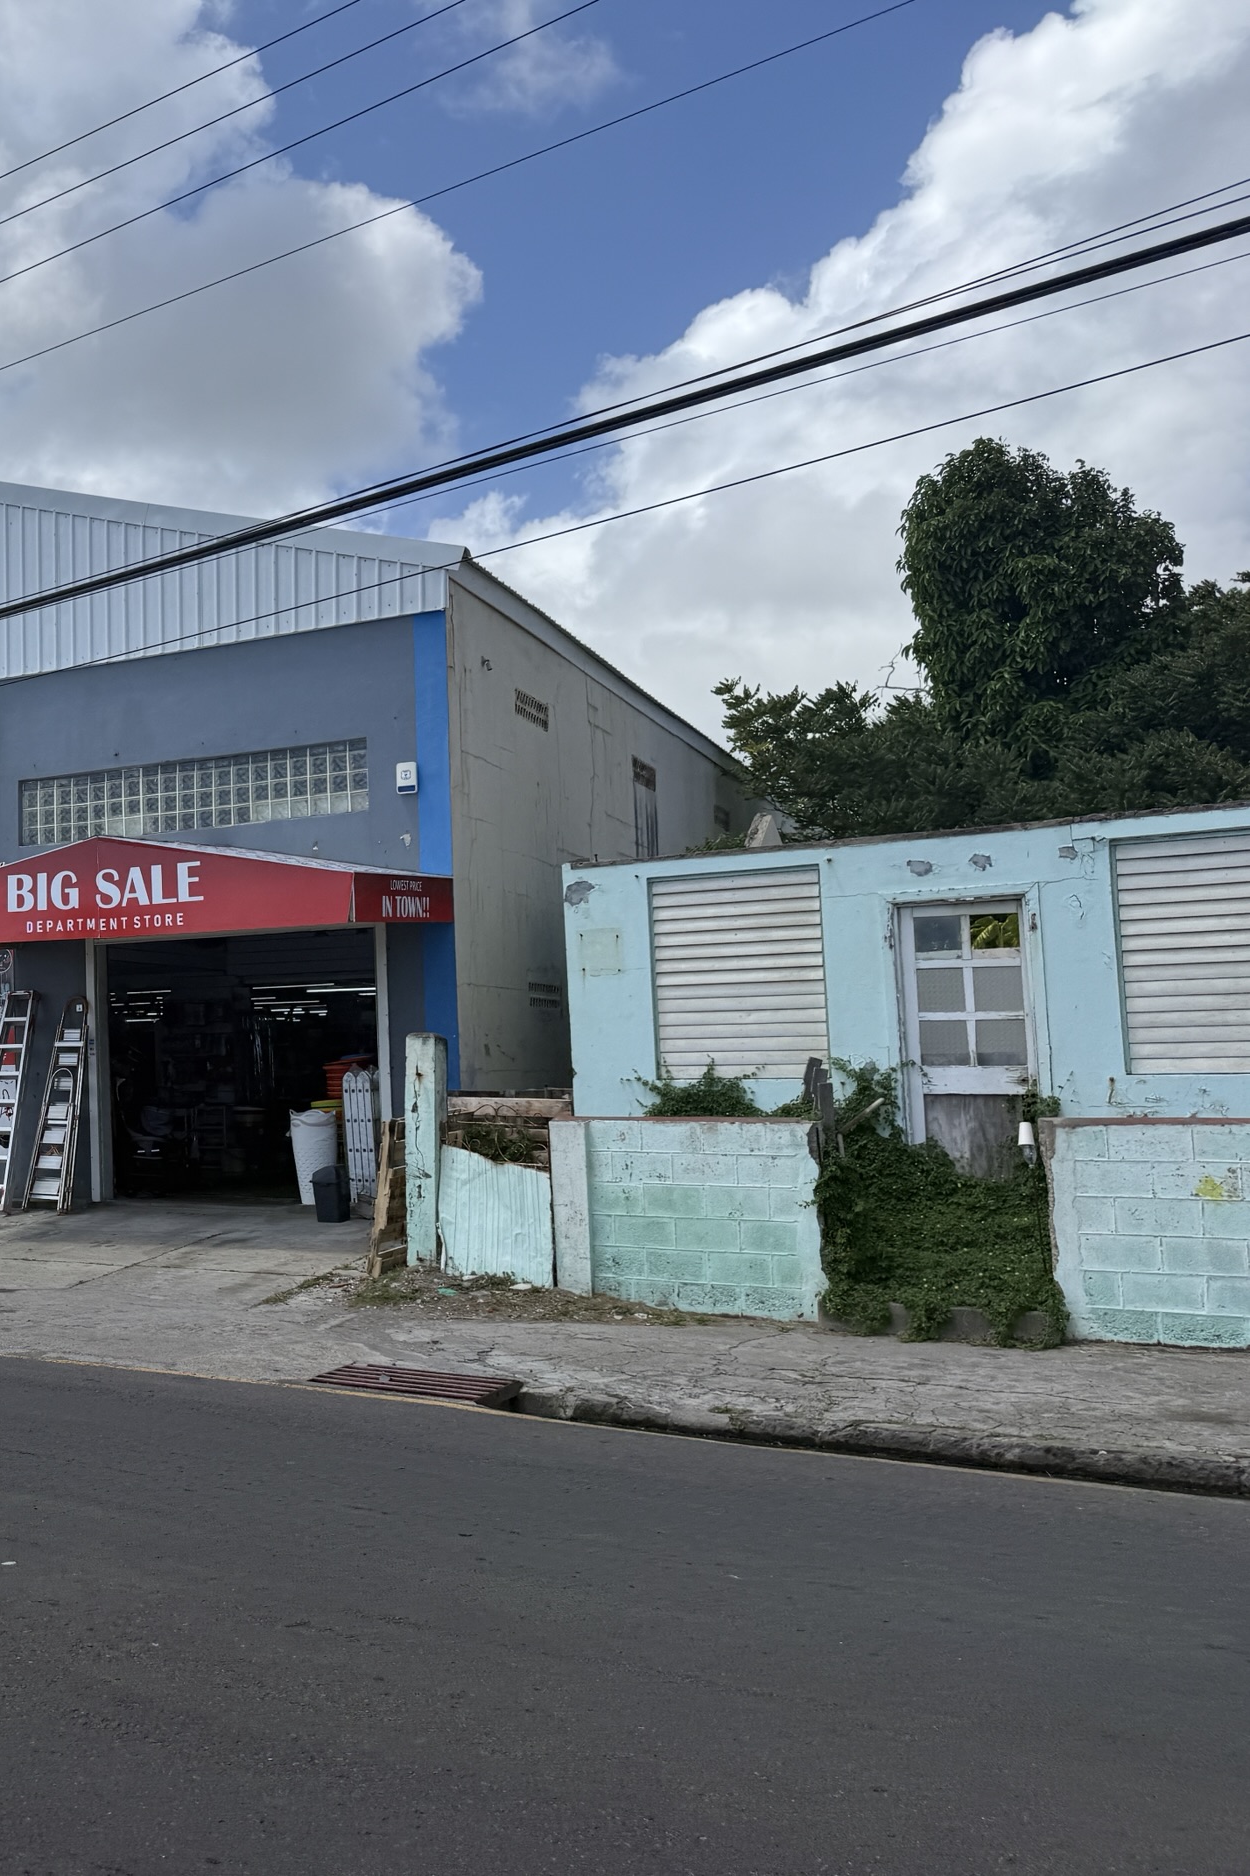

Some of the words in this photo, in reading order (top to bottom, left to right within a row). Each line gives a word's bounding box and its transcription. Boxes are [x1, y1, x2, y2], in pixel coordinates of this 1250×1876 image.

[7, 870, 79, 912] BIG
[95, 861, 204, 909] SALE
[390, 880, 409, 891] LOWEST
[409, 881, 422, 892] PRICE
[382, 895, 393, 918] IN
[395, 895, 430, 918] TOWN!!
[26, 917, 127, 933] DEPARTMENT
[133, 912, 184, 928] STORE
